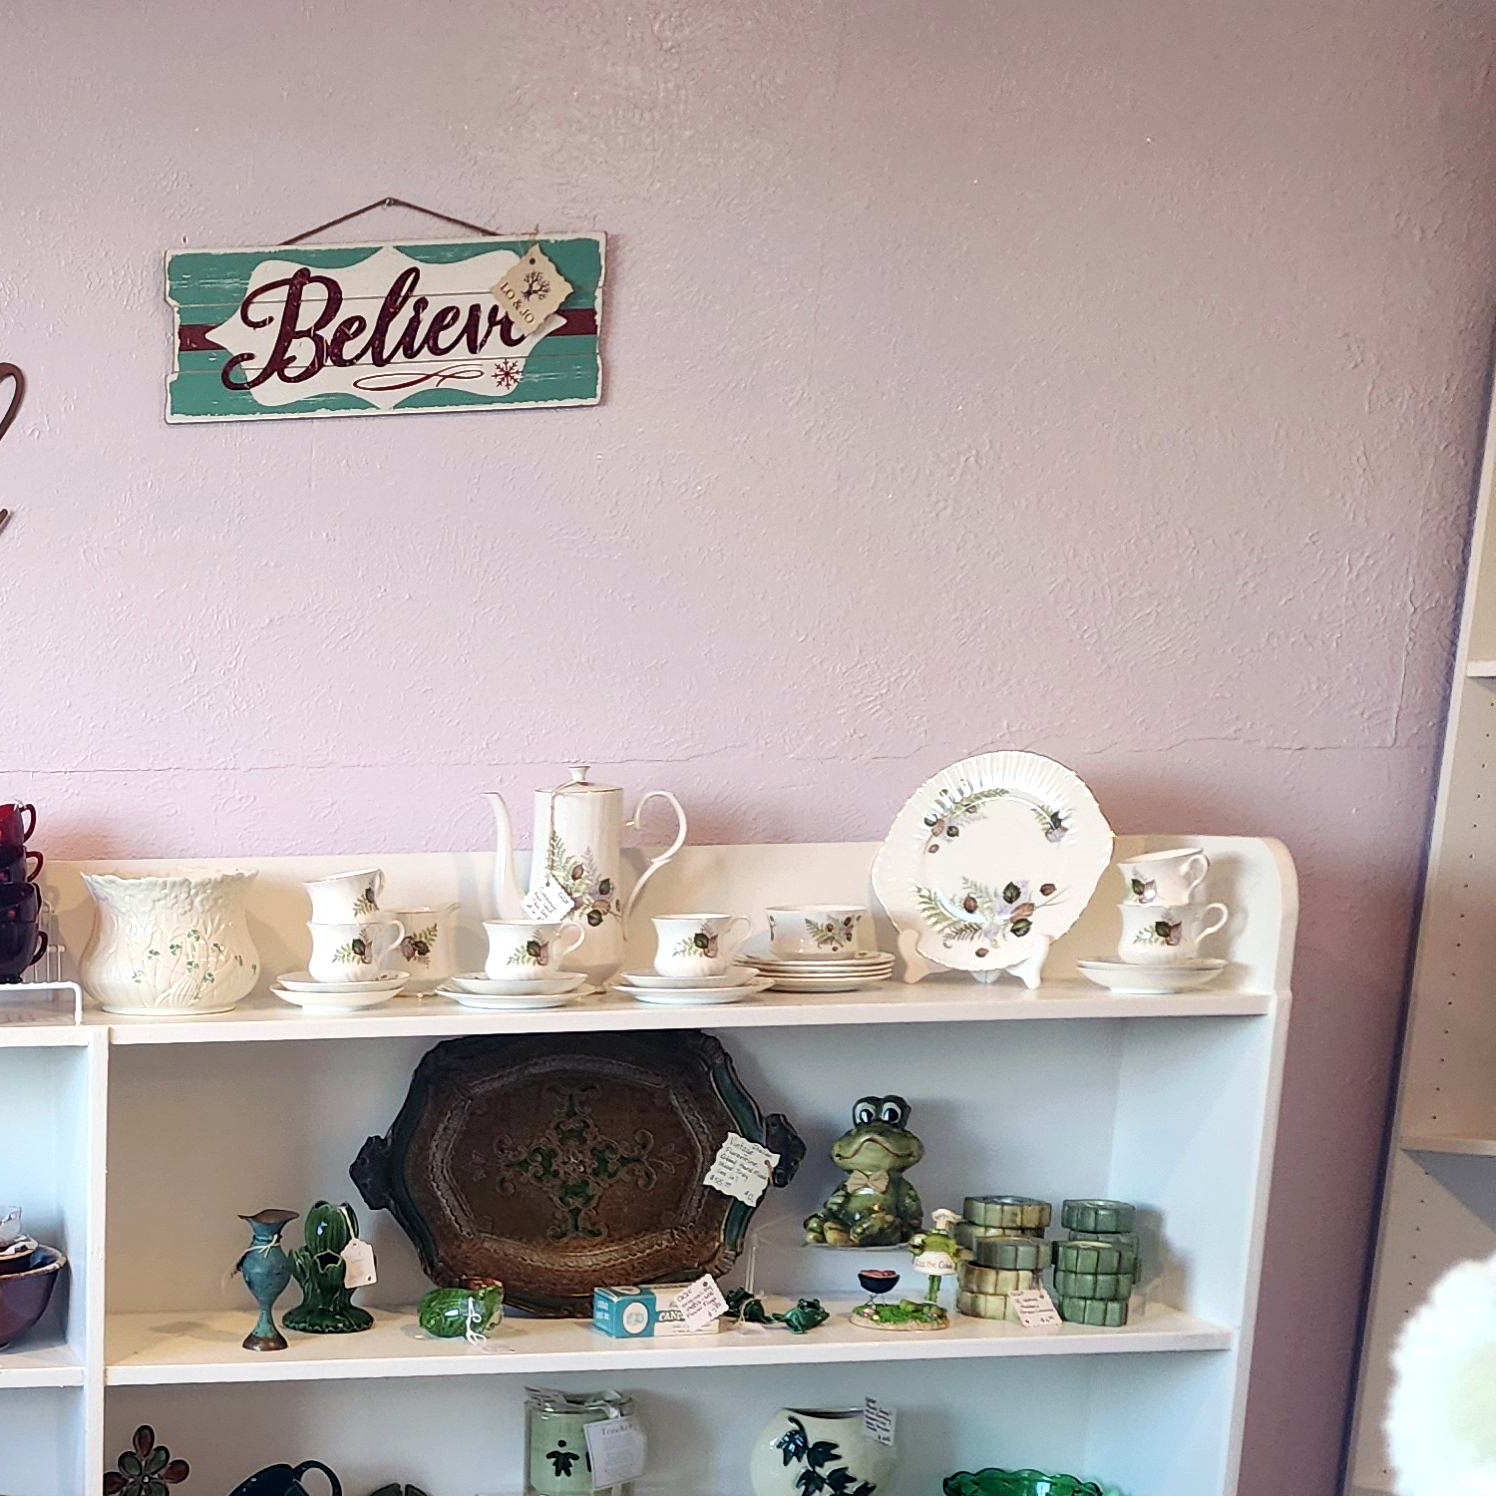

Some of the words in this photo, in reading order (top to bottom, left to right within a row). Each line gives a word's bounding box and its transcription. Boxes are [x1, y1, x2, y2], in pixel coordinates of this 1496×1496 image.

[500, 281, 515, 299] LO
[519, 309, 534, 323] JO
[601, 1424, 633, 1436] Teacher
